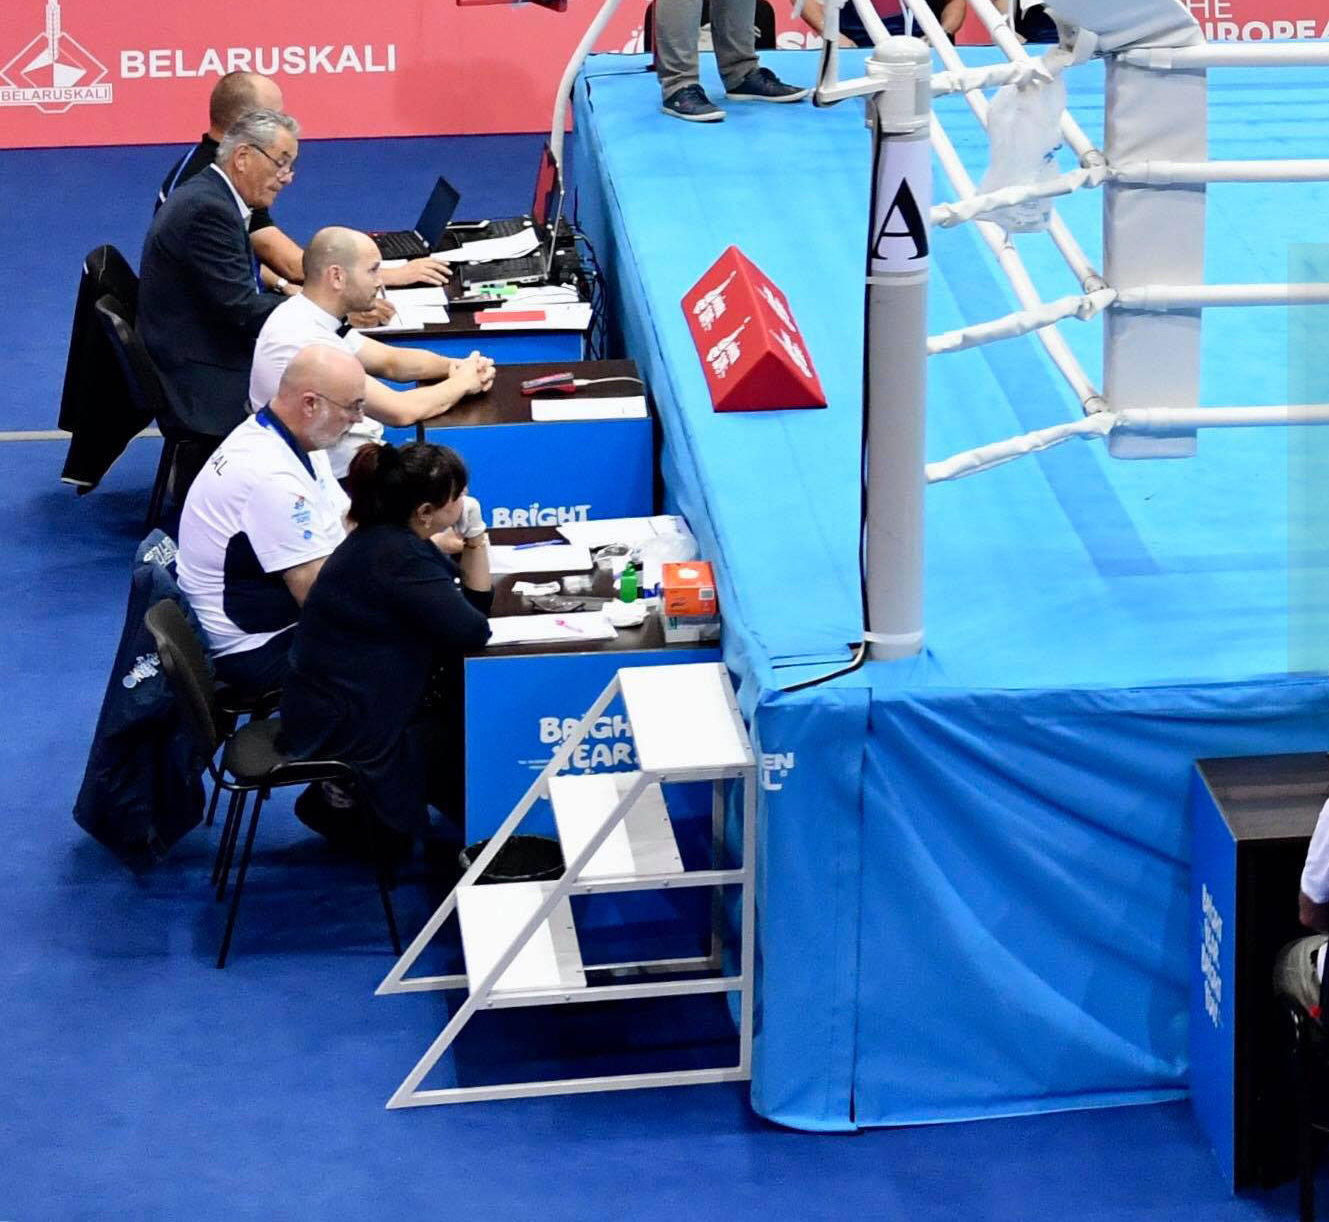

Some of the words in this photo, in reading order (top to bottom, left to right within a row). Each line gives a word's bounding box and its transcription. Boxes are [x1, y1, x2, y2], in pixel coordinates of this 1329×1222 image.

[120, 44, 397, 79] BELARUSKALI
[1, 87, 110, 104] BELARUSKALI
[873, 177, 930, 261] A
[492, 503, 592, 529] BRIGHT
